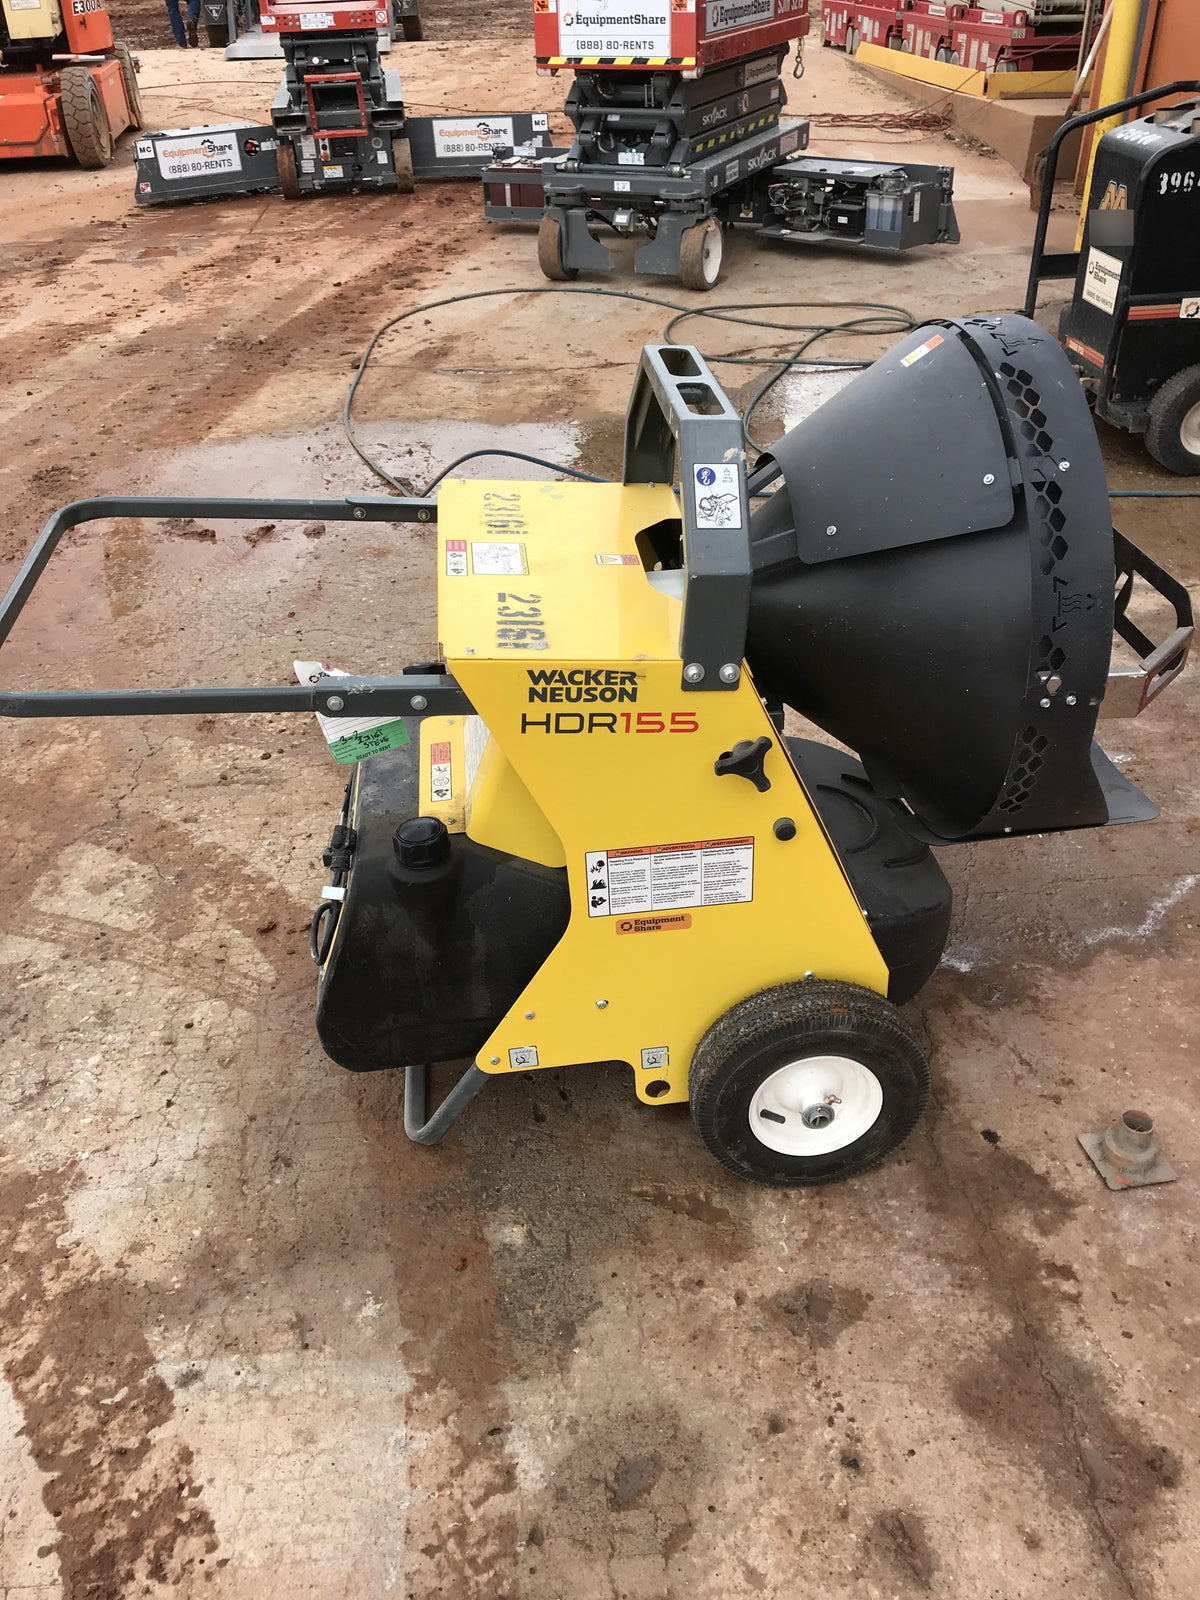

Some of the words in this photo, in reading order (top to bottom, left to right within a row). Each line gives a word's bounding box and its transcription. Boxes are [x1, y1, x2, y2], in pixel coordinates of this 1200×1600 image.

[575, 14, 666, 27] EquipmentShare
[576, 40, 603, 50] (888)
[606, 40, 654, 50] 80-RENTS
[439, 127, 508, 138] EquipmentShare
[162, 144, 233, 158] EquipmentShare
[443, 144, 464, 153] (888)
[168, 163, 190, 175] (888)
[191, 159, 233, 172] 80-RENTS
[1157, 171, 1200, 195] 396
[526, 669, 638, 686] WACKER
[528, 687, 638, 703] NEUSON
[521, 712, 699, 734] HDR155
[634, 916, 685, 926] Equipment
